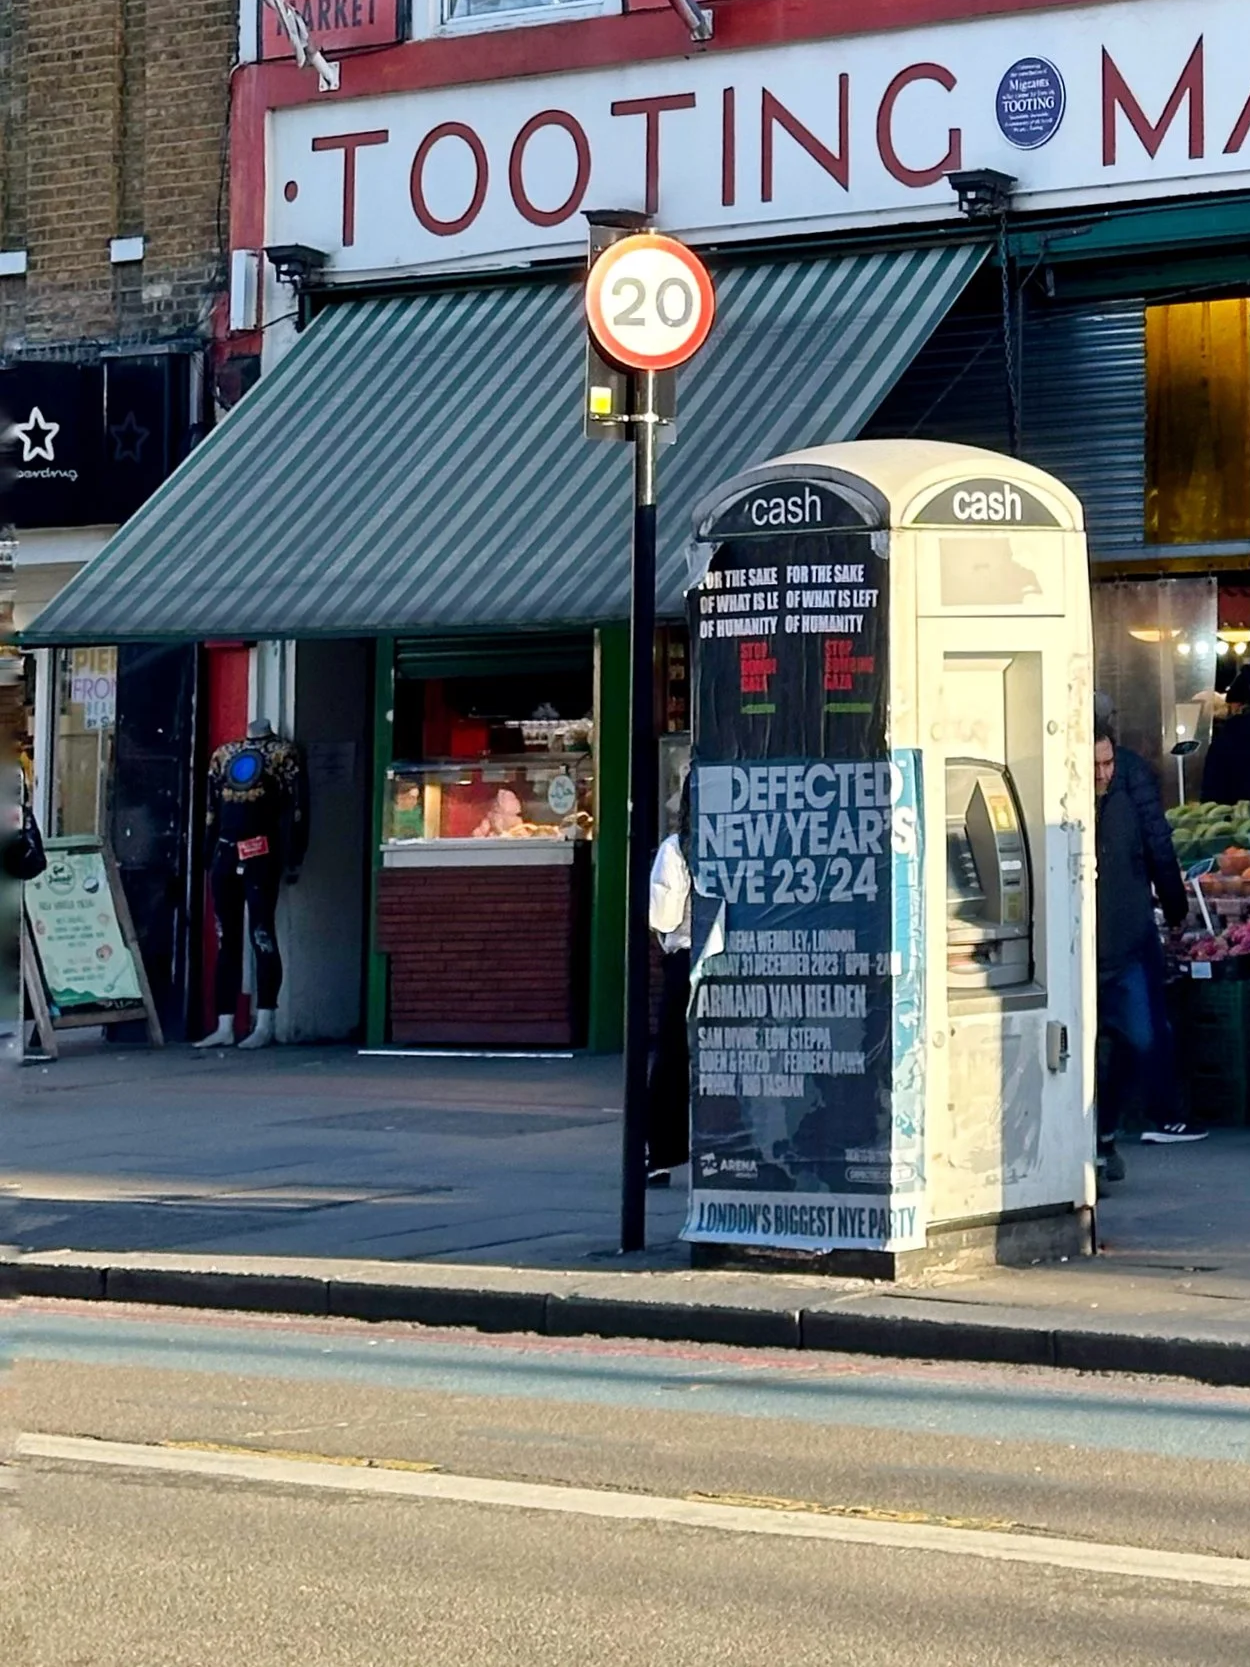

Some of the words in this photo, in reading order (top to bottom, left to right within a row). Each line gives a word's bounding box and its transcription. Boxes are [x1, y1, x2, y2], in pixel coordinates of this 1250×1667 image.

[1002, 96, 1055, 113] TOOTING
[312, 62, 962, 247] TOOTING
[610, 277, 695, 328] 20
[751, 487, 822, 526] cash
[953, 484, 1022, 520] cash
[700, 570, 723, 590] OR
[725, 569, 746, 588] THE
[748, 567, 778, 586] SAKE
[786, 565, 808, 584] FOR
[811, 565, 832, 583] THE
[834, 564, 865, 583] SAKE
[700, 596, 715, 615] OF
[716, 593, 750, 613] WHAT
[753, 592, 766, 610] IS
[785, 591, 801, 609] OF
[802, 590, 836, 609] WHAT
[838, 590, 851, 608] IS
[853, 589, 879, 608] LEFT
[700, 620, 715, 639] OF
[716, 616, 779, 638] HUMANITY
[785, 615, 800, 633] OF
[801, 614, 864, 633] HUMANITY
[698, 762, 904, 814] DEFECTED
[698, 812, 782, 858] NEW
[785, 806, 918, 857] YEAR'S
[698, 860, 766, 904] EVE
[771, 857, 879, 904] 23/24
[812, 929, 856, 952] LONDON
[754, 953, 810, 976] DECEMBER
[811, 953, 838, 976] 2023
[697, 984, 768, 1018] ARMAND
[769, 984, 803, 1018] VAN
[804, 984, 867, 1018] HELDEN
[697, 1201, 772, 1234] LONDON'S
[775, 1204, 834, 1237] BIGGEST
[837, 1206, 865, 1238] NYE
[868, 1206, 916, 1239] PARTY
